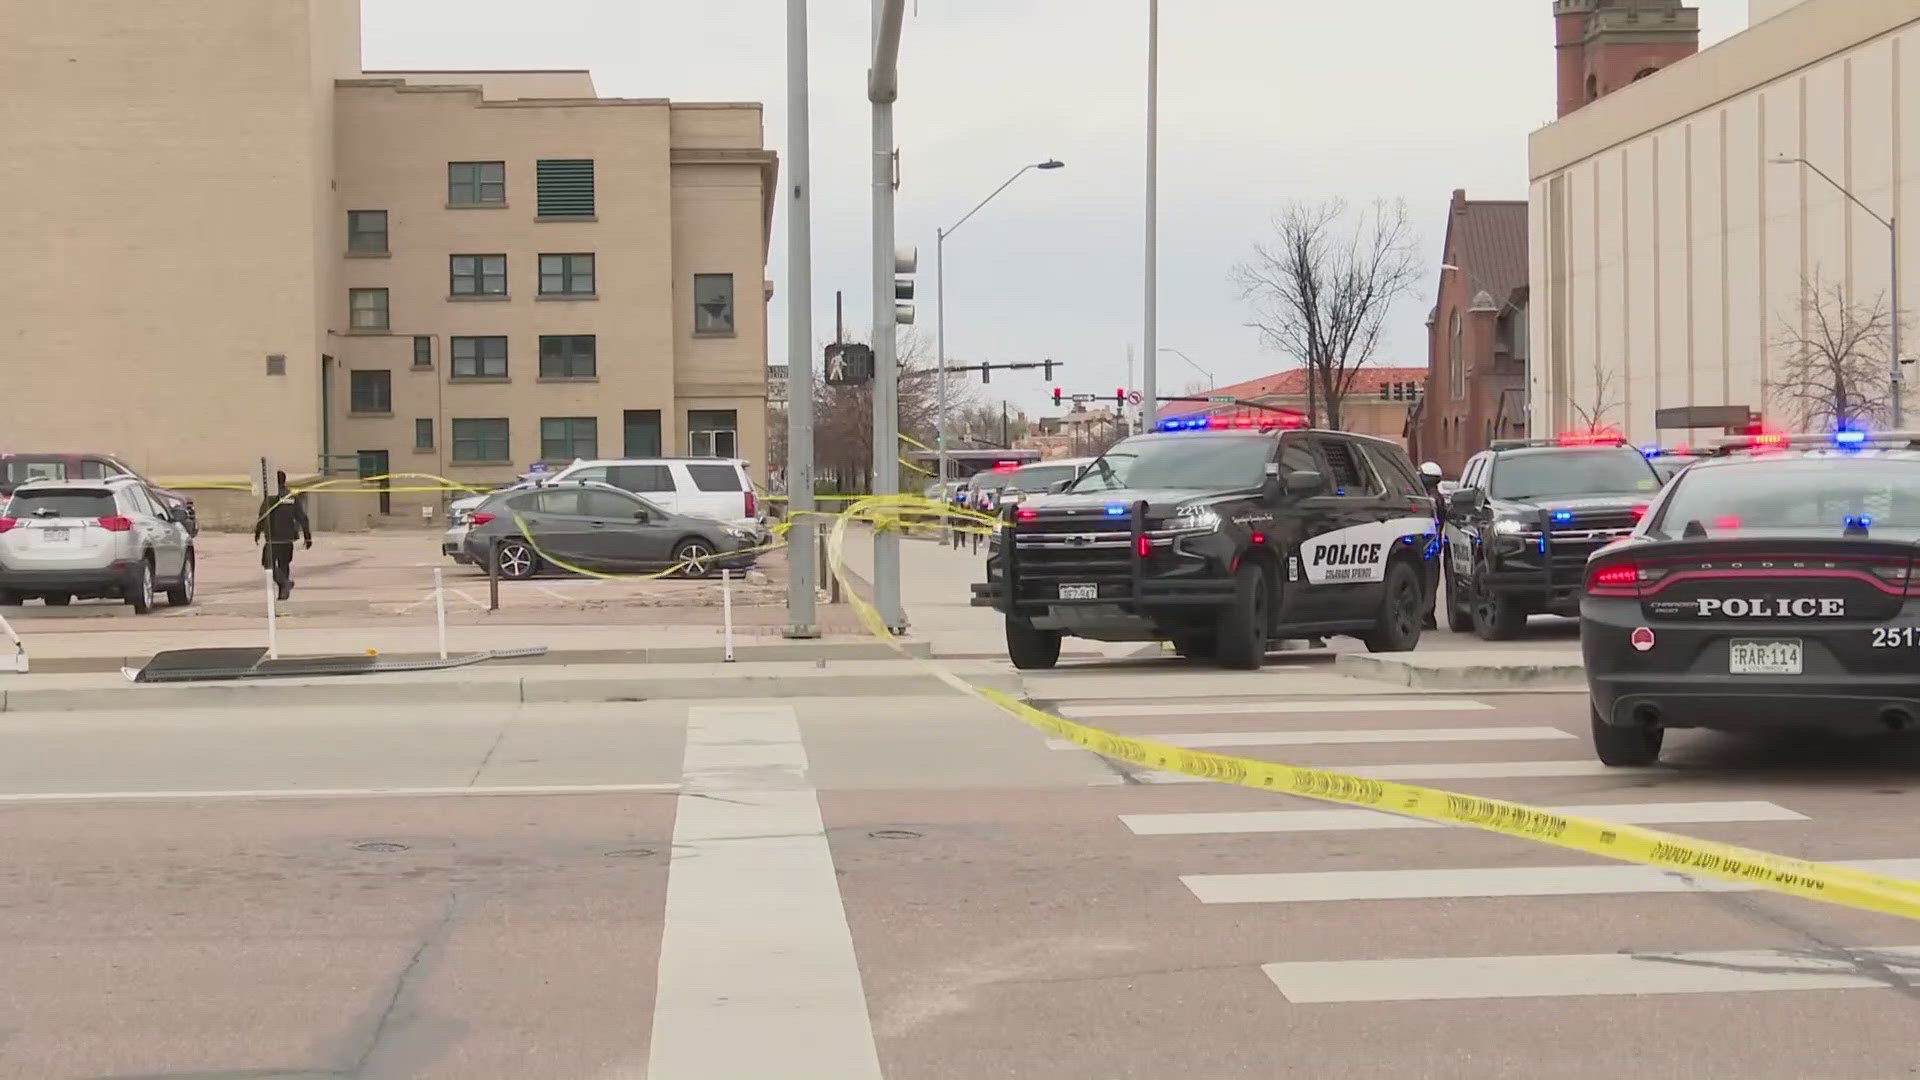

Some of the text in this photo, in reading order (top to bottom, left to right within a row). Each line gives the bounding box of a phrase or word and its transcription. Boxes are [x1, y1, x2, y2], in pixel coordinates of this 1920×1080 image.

[1176, 505, 1205, 516] 2211
[1313, 543, 1381, 566] POLICE
[1697, 598, 1844, 617] POLICE
